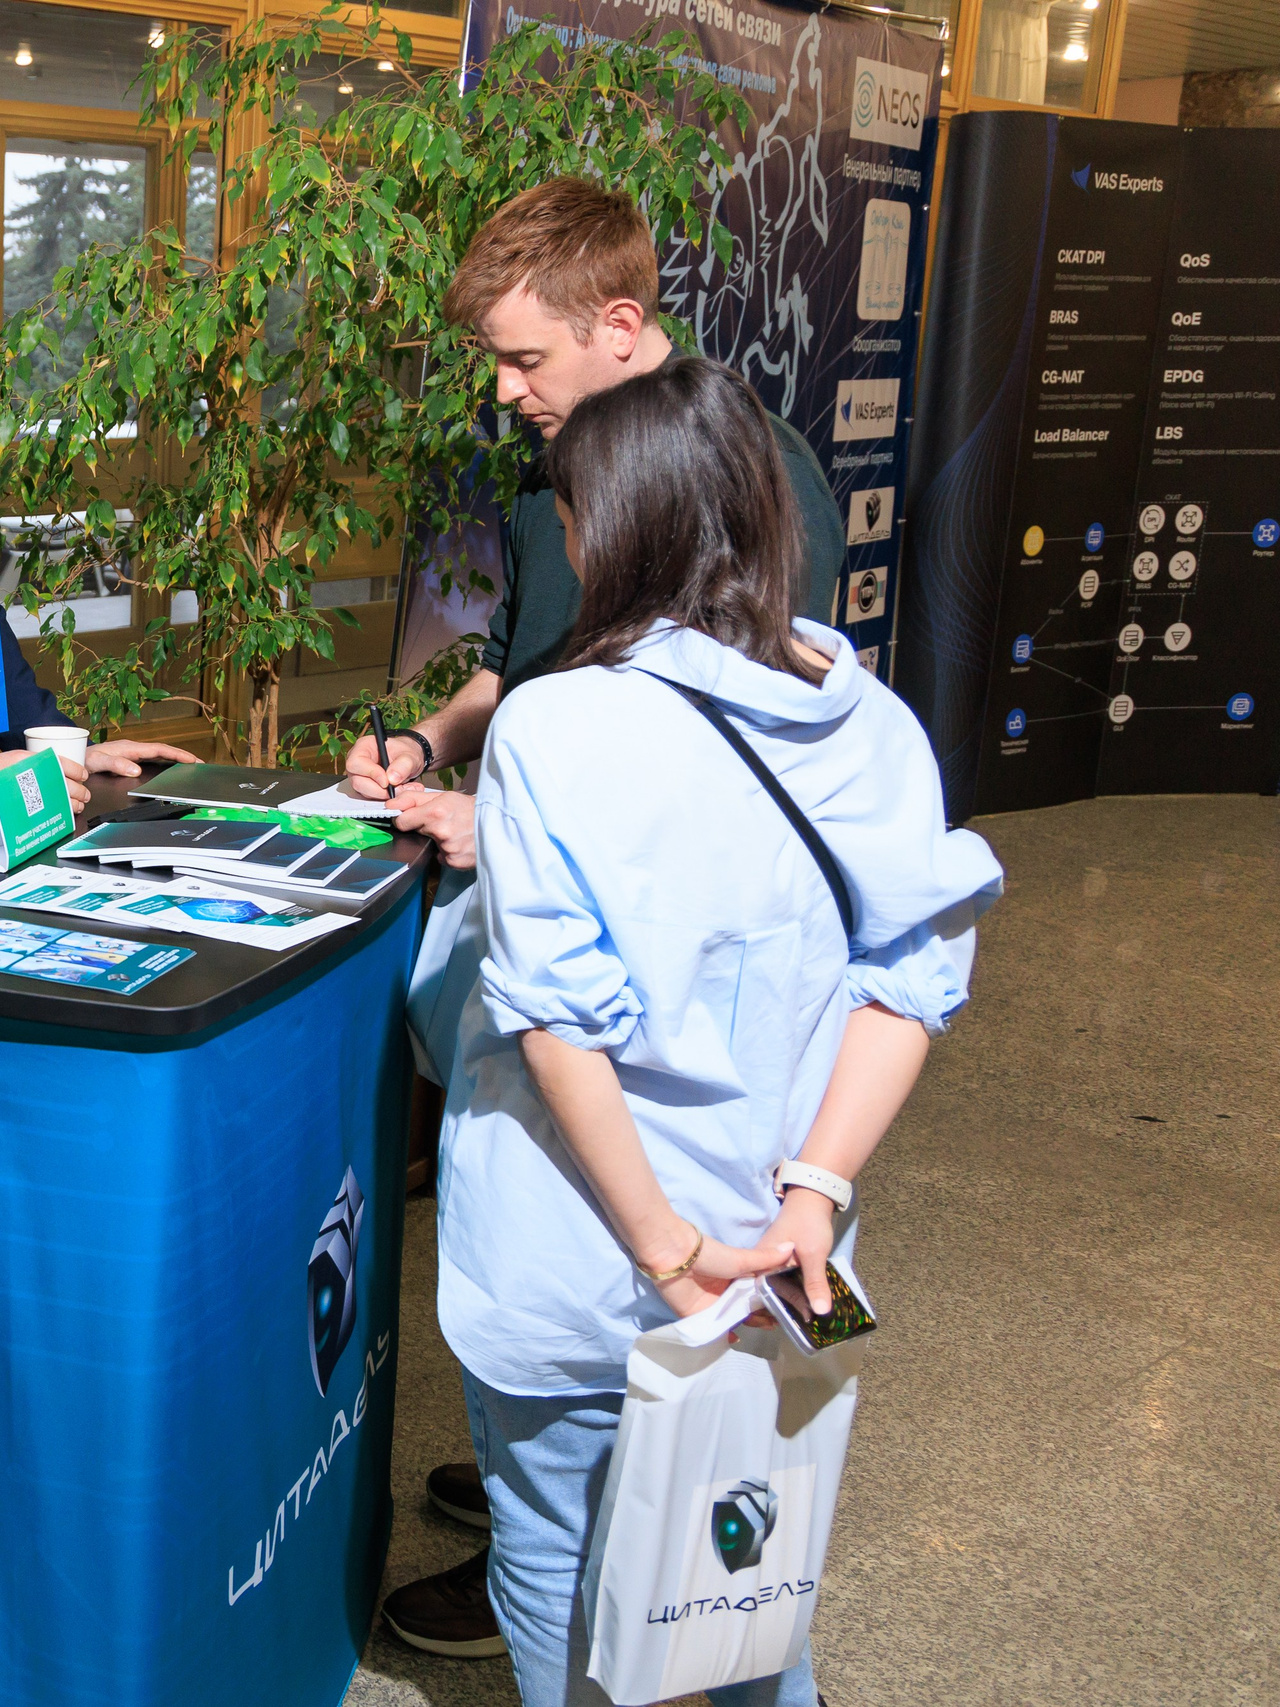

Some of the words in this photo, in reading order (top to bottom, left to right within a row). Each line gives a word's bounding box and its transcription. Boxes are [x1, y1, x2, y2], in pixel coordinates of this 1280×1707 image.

[737, 11, 782, 46] связи
[877, 85, 921, 129] NEOS
[1094, 172, 1118, 189] VAS
[1119, 173, 1164, 194] Experts
[1086, 250, 1106, 265] DPI
[1179, 253, 1211, 268] QoS
[1049, 310, 1079, 324] BRAS
[1171, 311, 1202, 326] QoE
[1041, 370, 1085, 384] CG-NAT
[1163, 370, 1204, 384] EPDG
[855, 402, 870, 420] VAS
[870, 402, 894, 423] Experts
[1034, 429, 1061, 443] Load
[1061, 428, 1110, 442] Balancer
[1155, 426, 1183, 440] LBS
[228, 1330, 390, 1606] ЦИТАДЕЛЬ
[647, 1579, 814, 1624] ЦИТАДЕЛЬ
